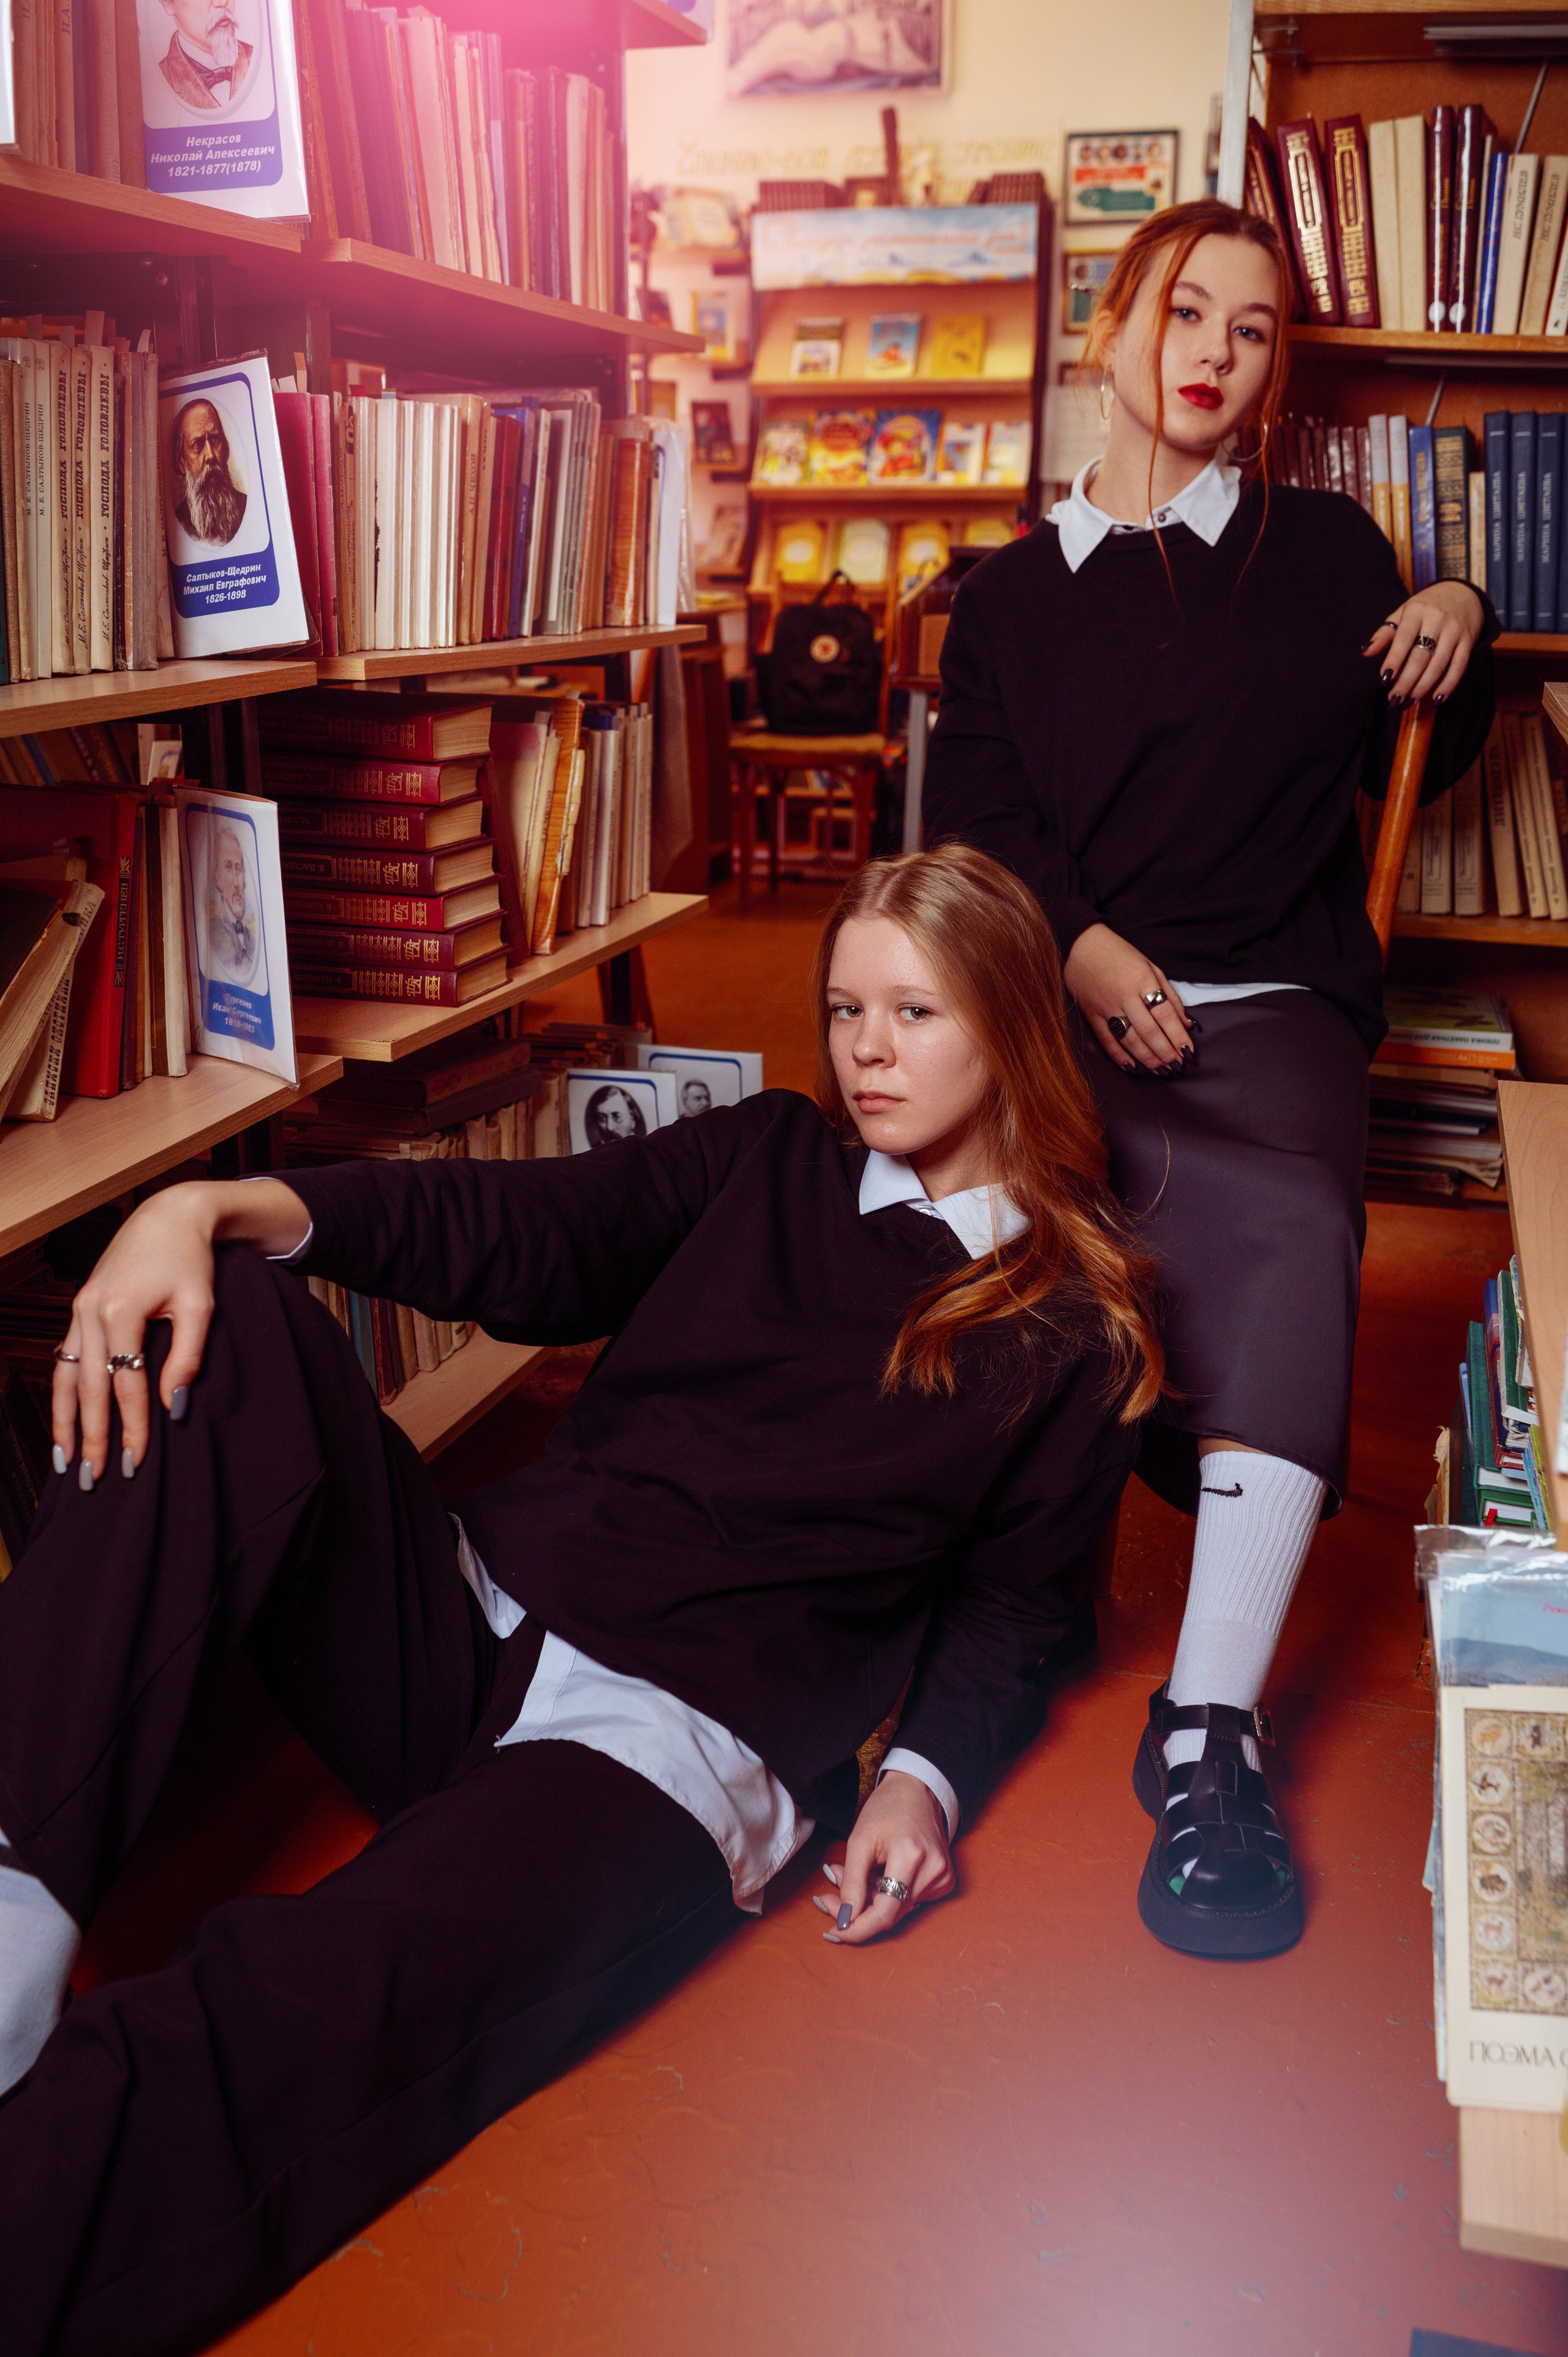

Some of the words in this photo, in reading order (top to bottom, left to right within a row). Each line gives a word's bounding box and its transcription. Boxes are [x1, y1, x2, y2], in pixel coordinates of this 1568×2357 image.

[186, 134, 241, 148] Некрасов
[151, 150, 202, 164] Николай
[205, 146, 275, 160] Алексеевич
[168, 160, 261, 177] 1821-1877(1878)
[59, 370, 67, 451] ГОЛОВЛЕВЫ
[76, 371, 88, 452] ГОЛОВЛЕВЫ
[100, 373, 110, 452] ГОЛОВЛЕВЫ
[76, 460, 85, 519] ГОСПОДА
[100, 460, 111, 519] ГОСПОДА
[26, 507, 32, 516] М.
[39, 507, 45, 516] М.
[186, 564, 261, 583] Салтыков-Щедрин
[183, 584, 214, 595] Михаил
[216, 575, 266, 590] Евграфович
[205, 589, 246, 604] 1826-1898
[224, 993, 252, 1009] Тургенев
[213, 1001, 230, 1013] Иван
[232, 1007, 262, 1025] Сергеевич
[1470, 2040, 1556, 2069] ПОЭМА
